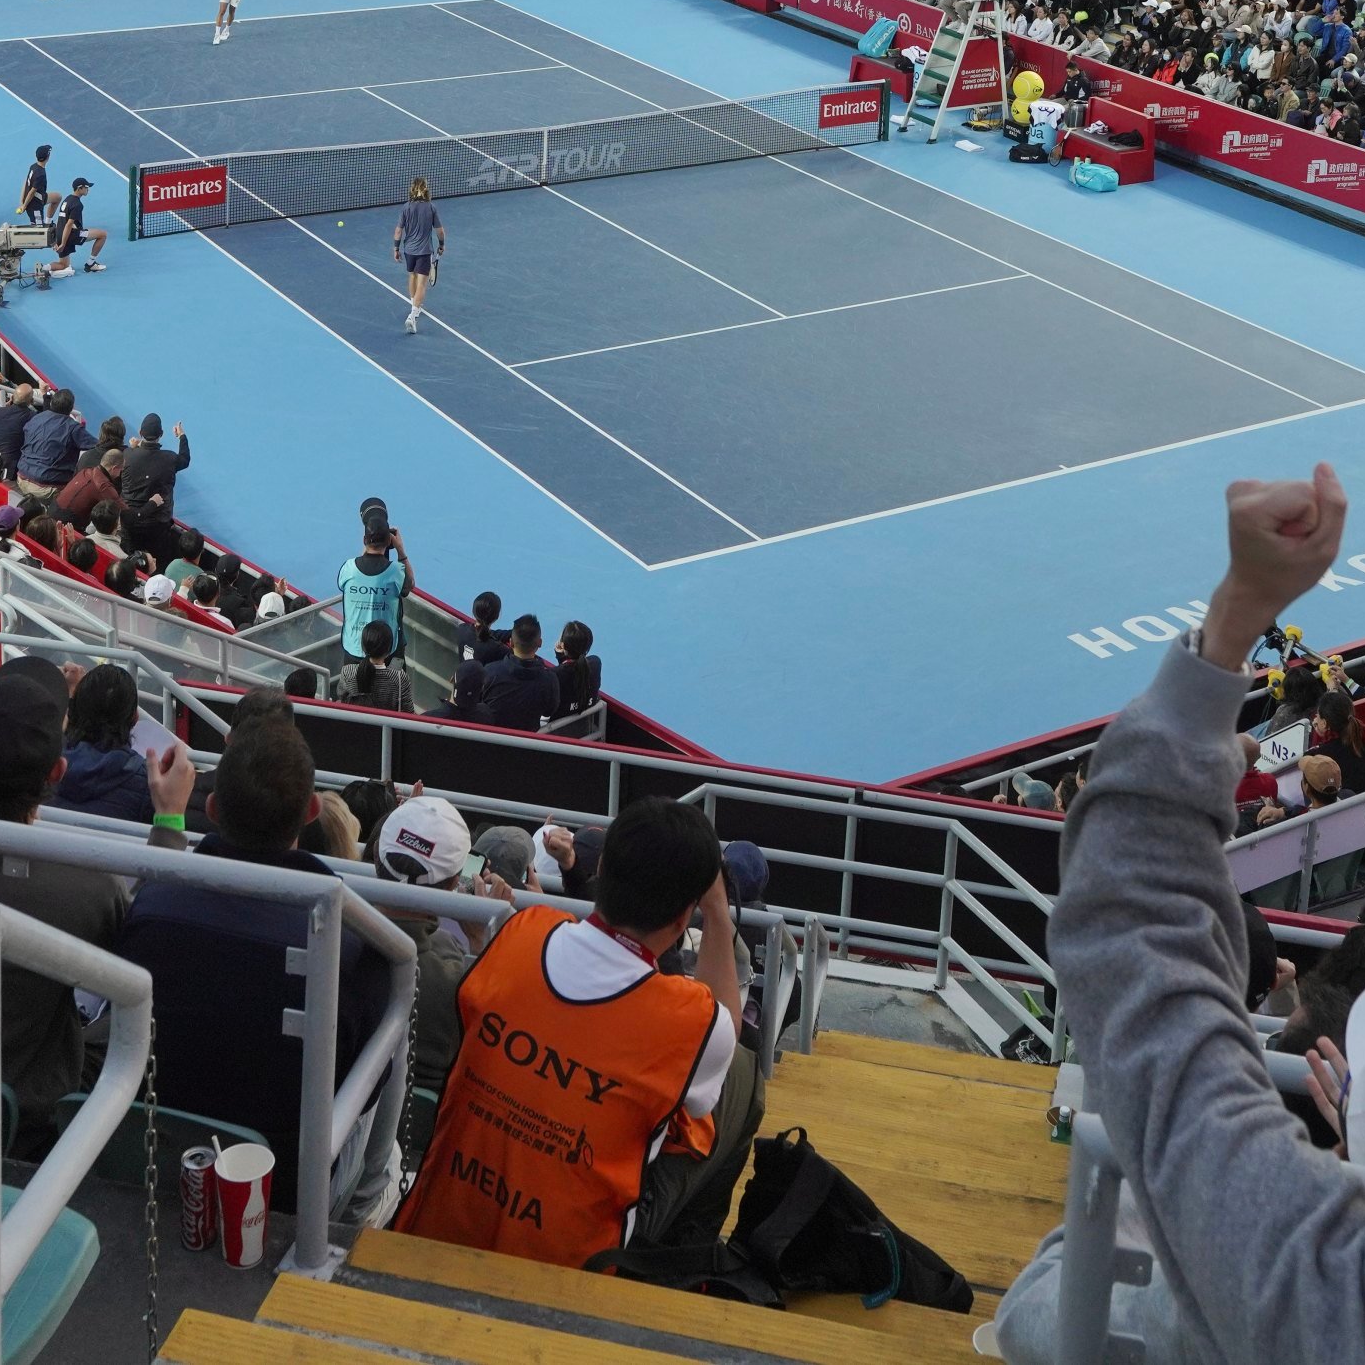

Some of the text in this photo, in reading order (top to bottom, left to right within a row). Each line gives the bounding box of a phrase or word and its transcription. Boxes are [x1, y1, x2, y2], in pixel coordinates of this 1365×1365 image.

[823, 98, 878, 118] Emirates
[468, 142, 626, 186] ATP TOUR
[147, 176, 224, 202] Emirates
[349, 585, 390, 596] SONY
[477, 1011, 623, 1105] SONY
[507, 1109, 573, 1149] TENNIS OPEN
[449, 1149, 544, 1231] MEDIA
